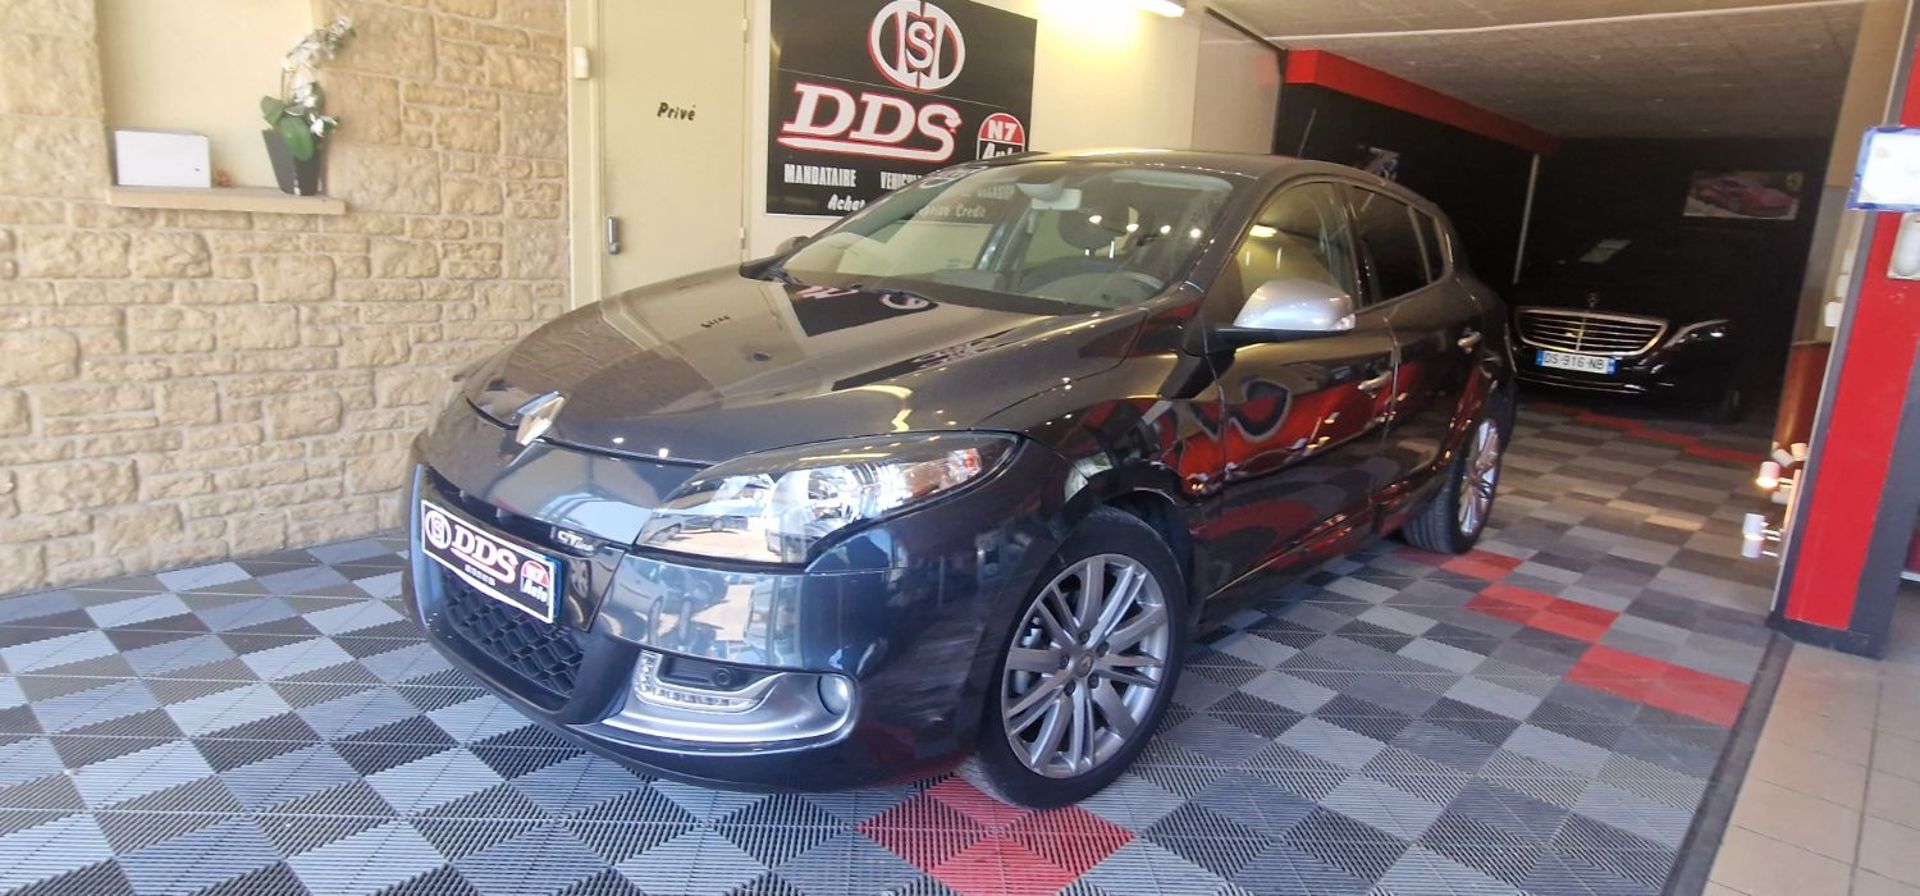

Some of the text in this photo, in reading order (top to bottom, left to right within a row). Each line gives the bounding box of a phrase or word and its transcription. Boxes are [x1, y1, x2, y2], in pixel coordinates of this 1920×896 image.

[778, 82, 962, 161] DDS
[988, 119, 1018, 142] N7
[784, 163, 857, 188] MANDATAIRE
[451, 524, 519, 584] DDS
